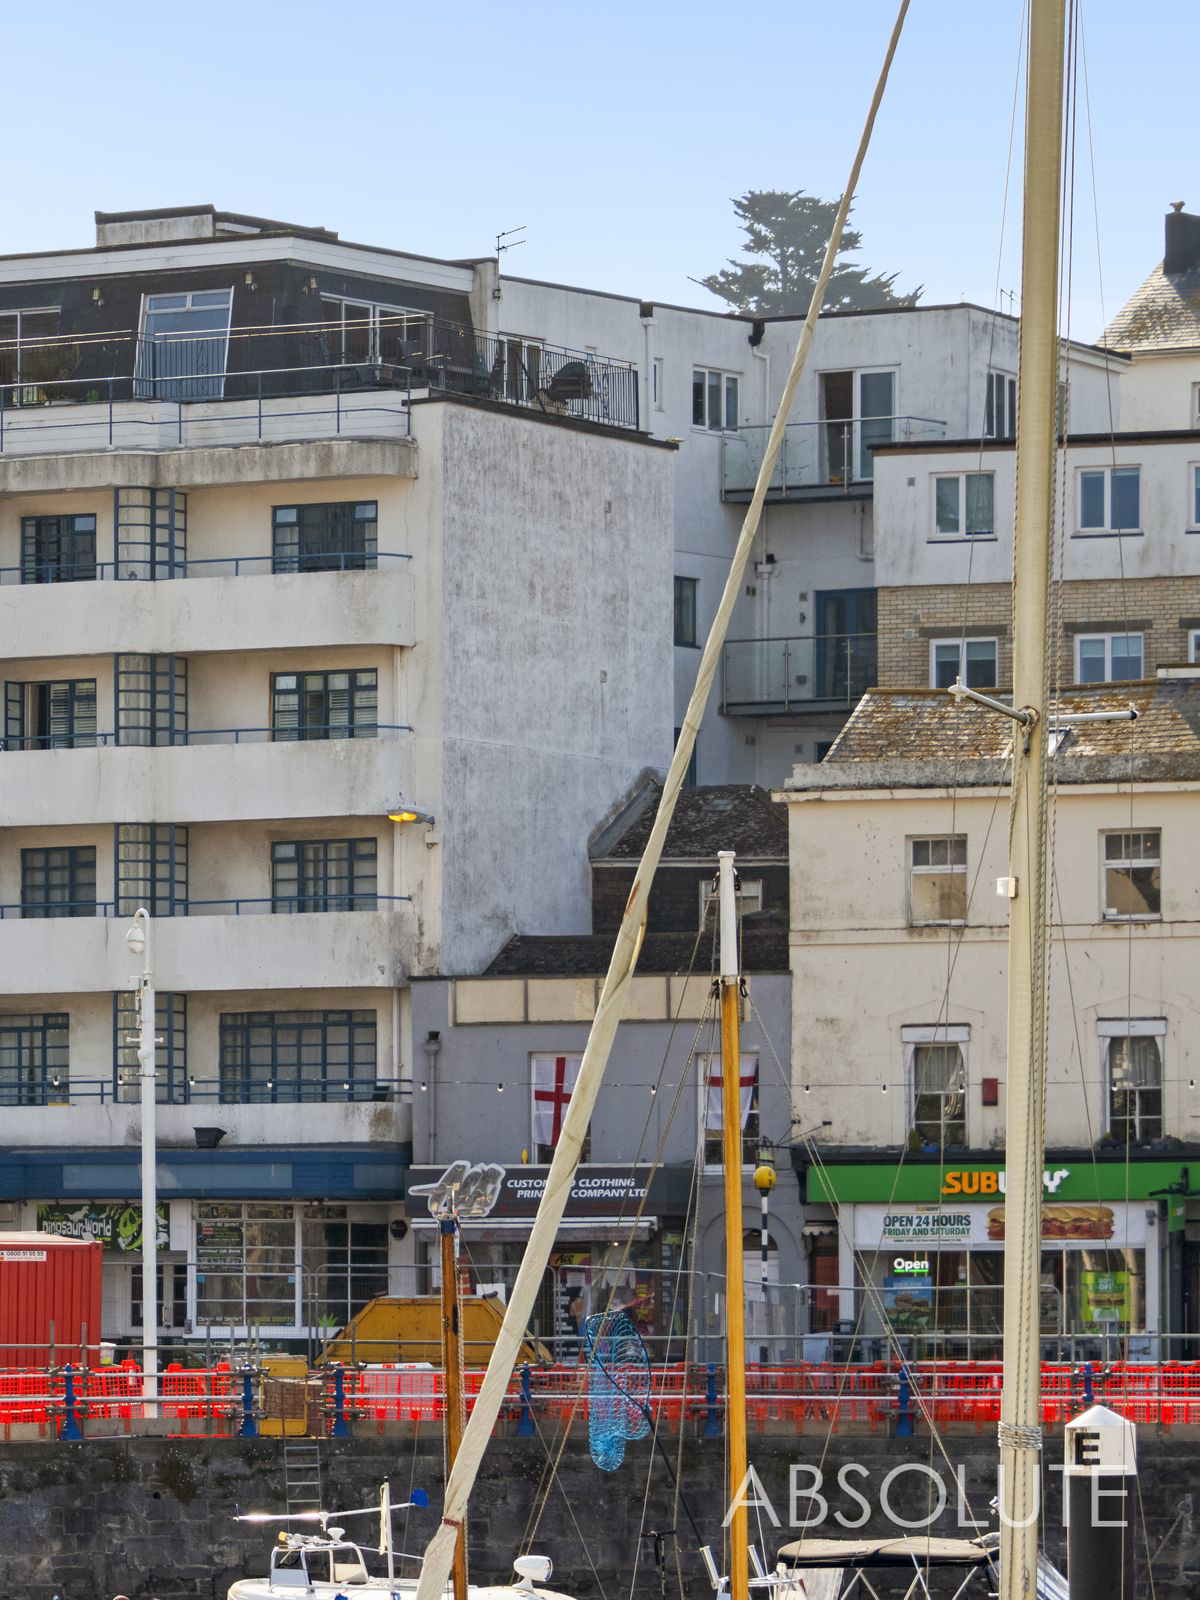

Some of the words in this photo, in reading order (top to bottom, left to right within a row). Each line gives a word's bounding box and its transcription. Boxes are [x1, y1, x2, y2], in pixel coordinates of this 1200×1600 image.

[579, 1178, 635, 1187] CLOTHING
[571, 1189, 625, 1198] COMPANY
[884, 1216, 913, 1227] OPEN
[915, 1215, 930, 1227] 24
[931, 1214, 971, 1226] HOURS
[883, 1228, 910, 1236] FRIDAY
[930, 1227, 971, 1235] SATURDAY
[893, 1258, 929, 1270] Open
[1075, 1432, 1100, 1465] E
